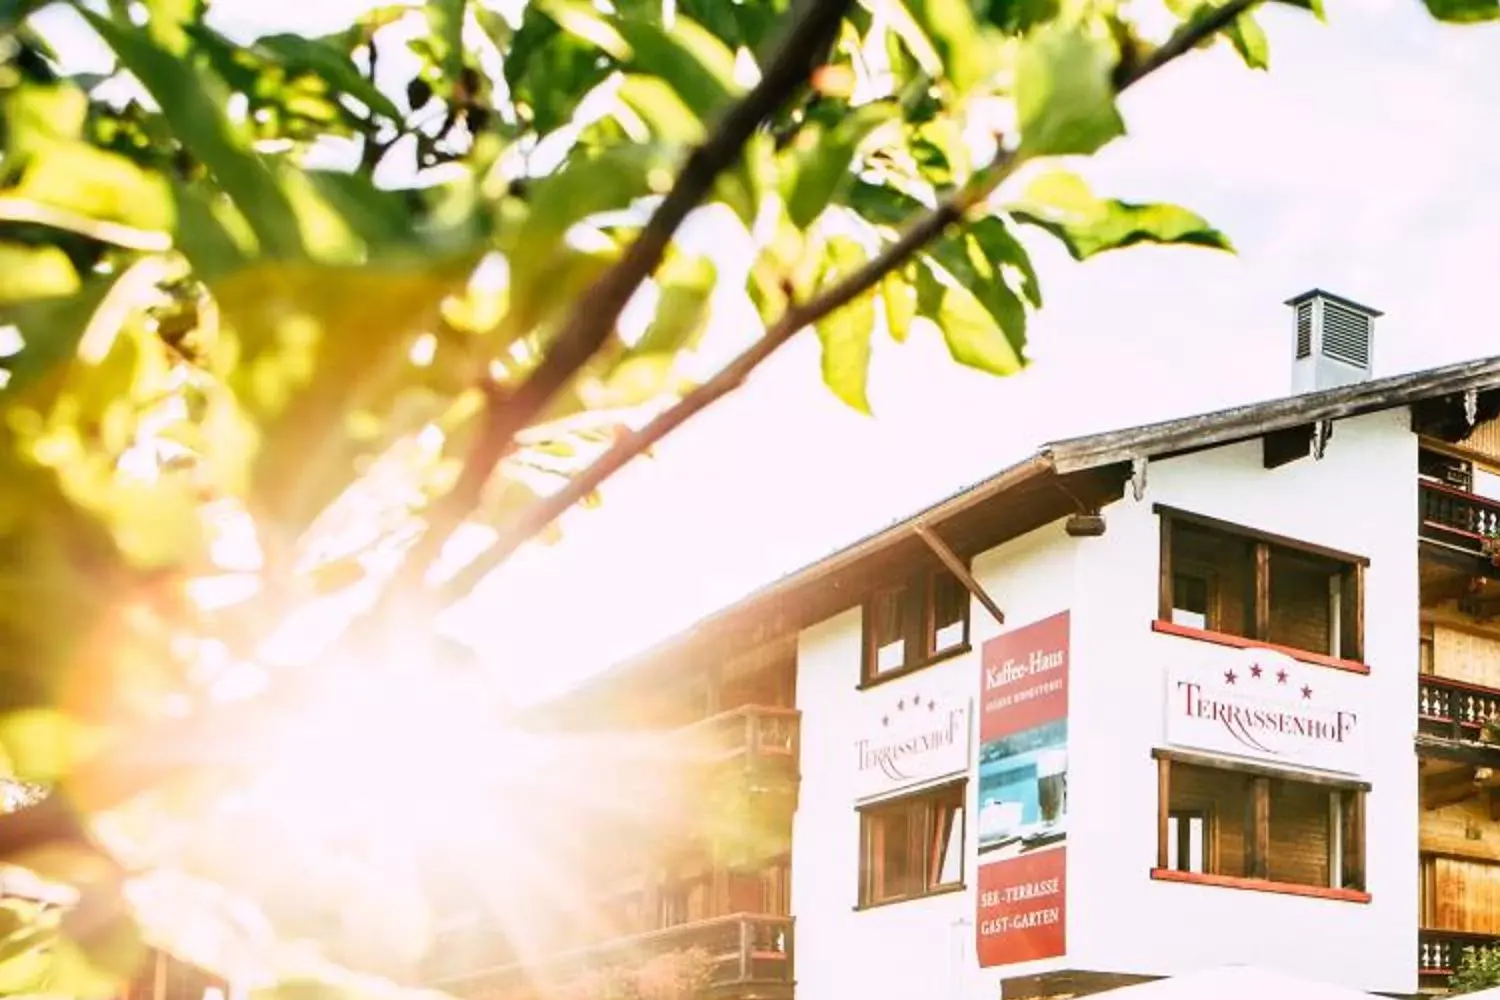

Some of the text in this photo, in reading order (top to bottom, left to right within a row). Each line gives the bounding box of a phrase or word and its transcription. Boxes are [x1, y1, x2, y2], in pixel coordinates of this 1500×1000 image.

[985, 649, 1064, 690] Kaffee-Haus
[1177, 680, 1357, 755] TERRASSENHOF
[981, 877, 1060, 908] SEE-TERRASSE
[981, 907, 1060, 935] GAST-GARTEN
